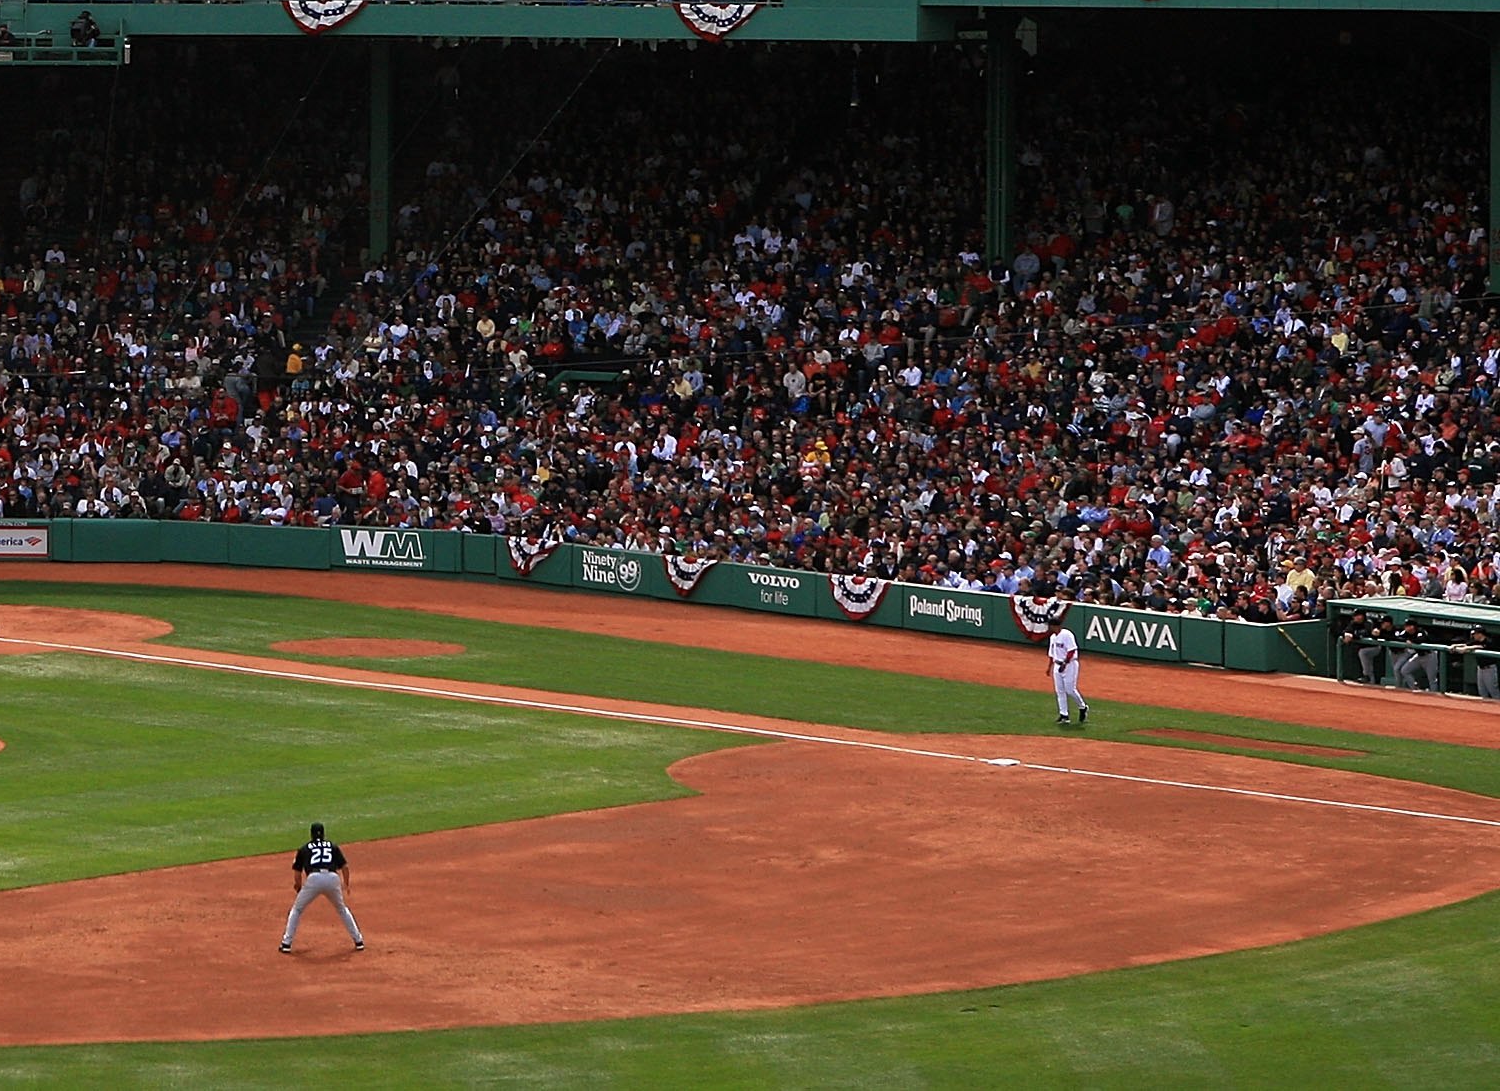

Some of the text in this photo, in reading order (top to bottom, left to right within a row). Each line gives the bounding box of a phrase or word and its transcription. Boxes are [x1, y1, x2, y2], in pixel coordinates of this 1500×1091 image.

[340, 530, 423, 559] WM
[371, 559, 423, 567] MANAGEMENT
[582, 550, 617, 569] Ninety
[582, 564, 616, 583] Nine
[747, 572, 800, 589] VOLVO
[760, 589, 789, 605] for life
[909, 594, 982, 627] Poland Spring
[1085, 615, 1177, 651] AVAYA
[1451, 620, 1472, 628] America
[310, 848, 333, 865] 25
